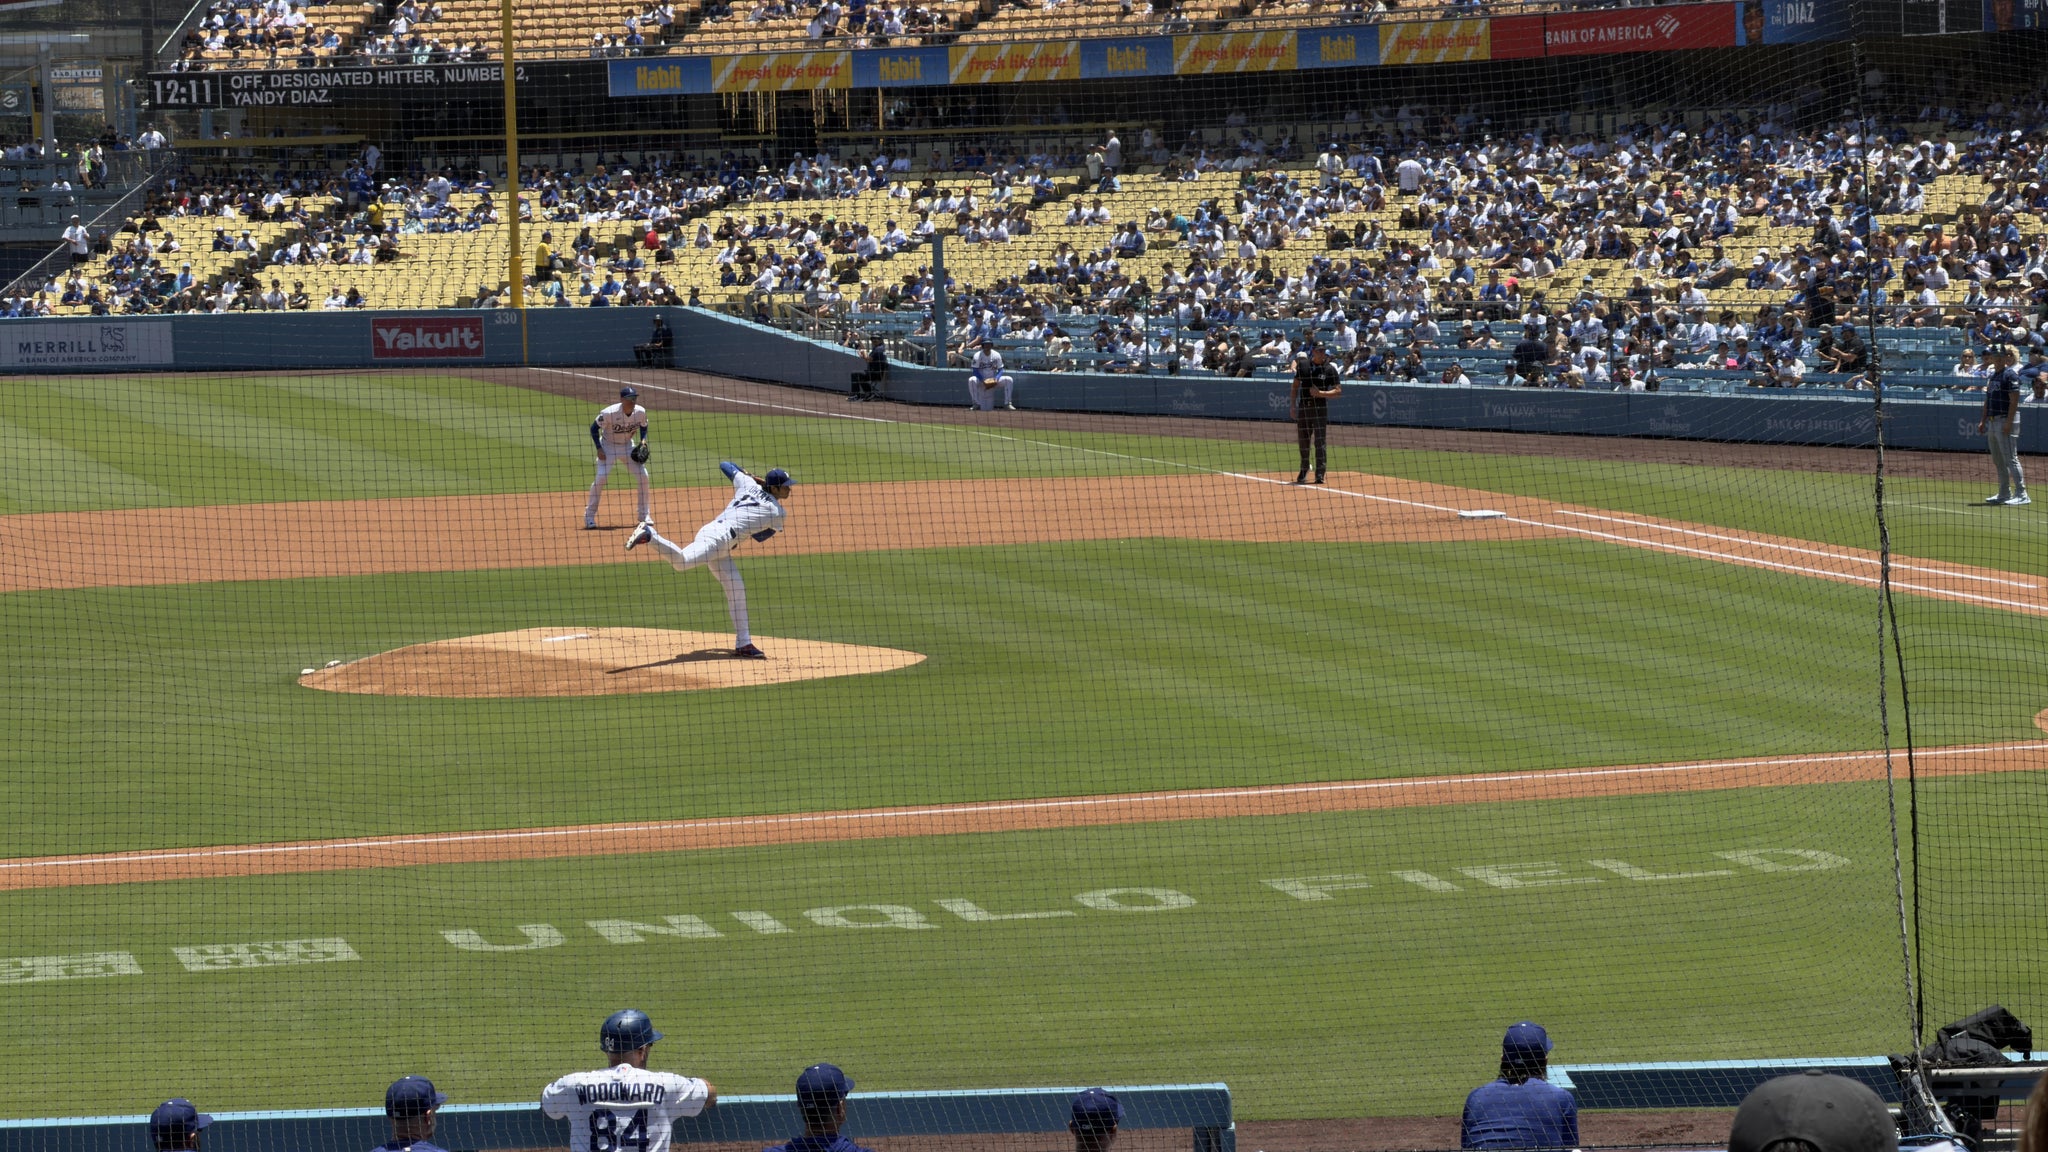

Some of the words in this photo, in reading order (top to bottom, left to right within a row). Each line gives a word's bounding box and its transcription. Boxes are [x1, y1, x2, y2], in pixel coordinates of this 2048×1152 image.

[1546, 30, 1577, 45] BANK
[1580, 28, 1595, 43] OF
[1599, 25, 1653, 41] AMERICA
[967, 56, 1005, 74] fresh
[1009, 54, 1035, 70] like
[1038, 53, 1070, 68] that
[1107, 45, 1147, 73] Habit
[1190, 46, 1228, 64] fresh
[1231, 45, 1256, 60] like
[1258, 43, 1287, 59] that
[230, 75, 266, 90] OFF,
[271, 71, 373, 88] DESIGNATED
[378, 69, 440, 86] HITTER,
[636, 65, 682, 90] Habit
[731, 65, 771, 84] fresh
[776, 63, 804, 79] like
[808, 62, 841, 78] that
[879, 56, 921, 81] Habit
[154, 79, 212, 104] 12:11
[231, 90, 287, 105] YANDY
[291, 89, 333, 104] DIAZ.
[494, 311, 517, 324] 330
[19, 341, 97, 354] MERRILL
[376, 327, 480, 350] Yakult
[440, 886, 1199, 952] UNIQLO
[1260, 847, 1852, 900] FIELD
[575, 1082, 665, 1106] WOODWARD
[589, 1108, 651, 1152] 84
